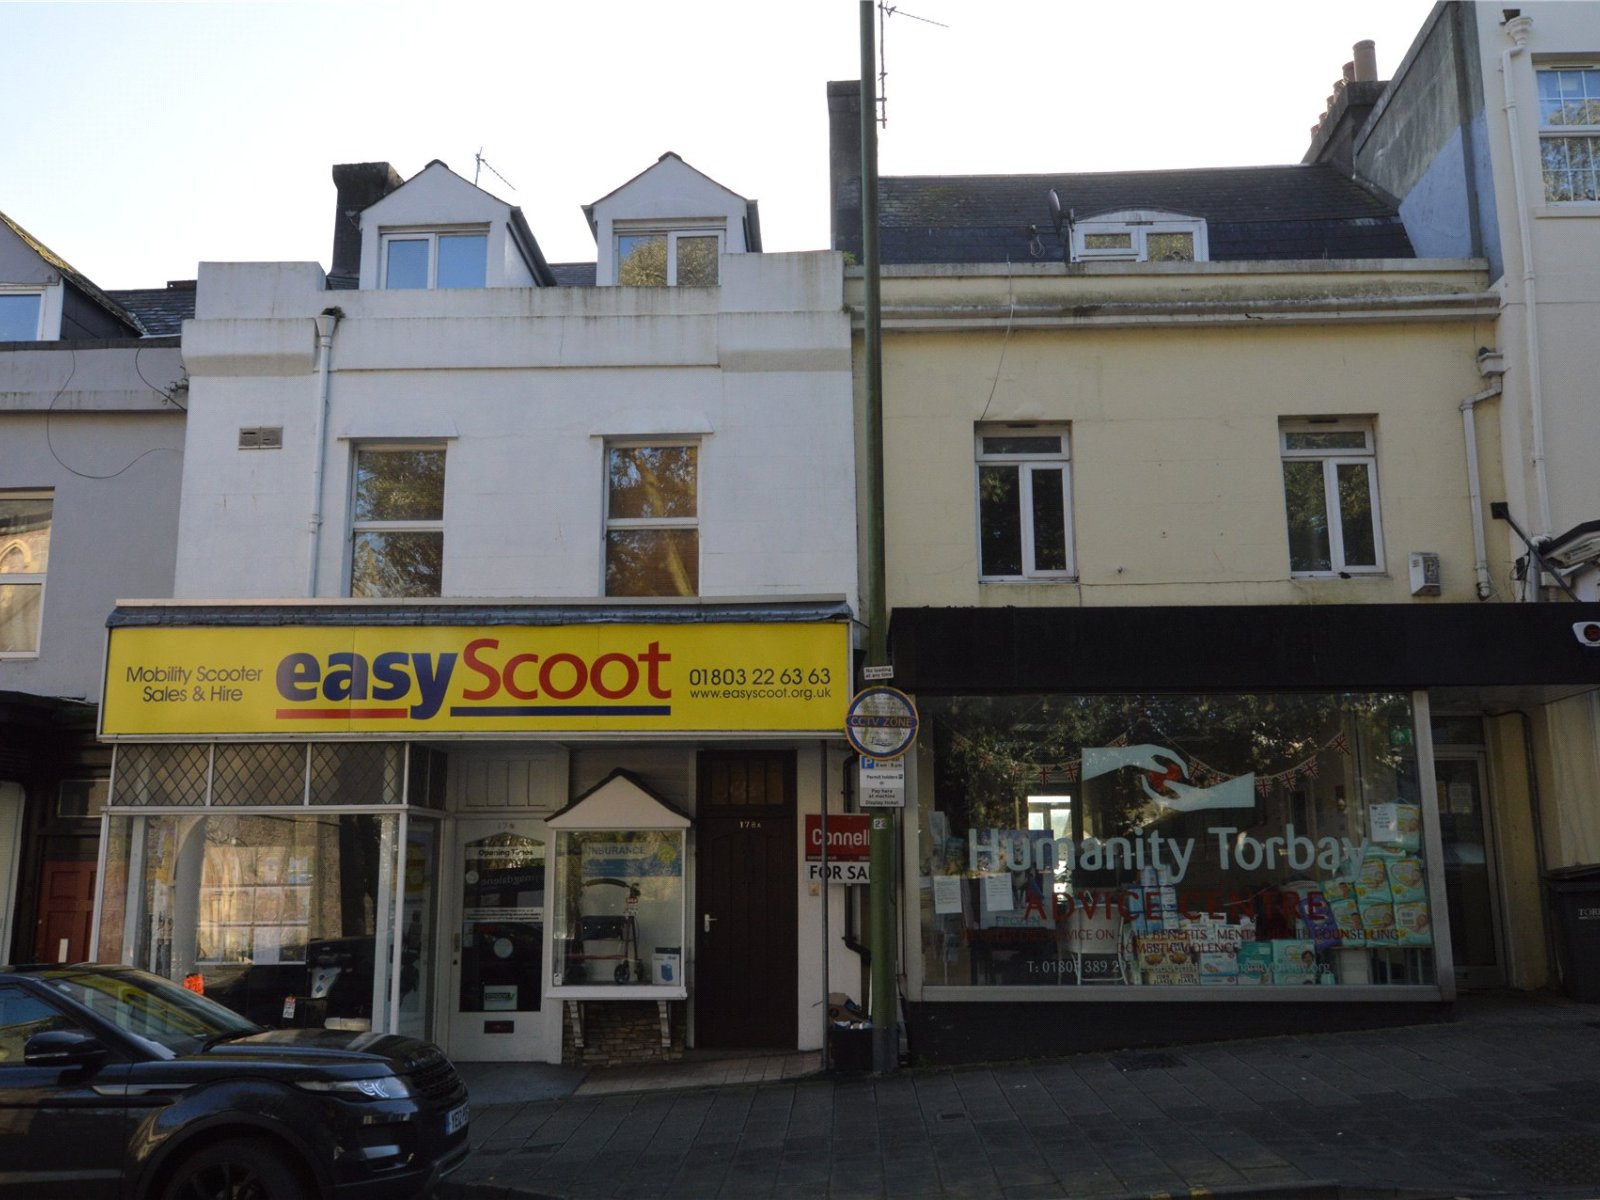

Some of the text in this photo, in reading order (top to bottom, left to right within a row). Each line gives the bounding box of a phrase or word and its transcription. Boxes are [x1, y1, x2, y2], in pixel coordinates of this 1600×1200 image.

[126, 665, 263, 685] Mobility Scooter
[689, 668, 831, 686] 01803 22 63 63
[143, 685, 243, 702] Sales & Hire
[690, 686, 832, 701] www.easyscoot.org.uk
[850, 716, 913, 727] CCTV ZONE
[478, 849, 510, 858] Opening
[968, 823, 1369, 884] Humanity Torbay
[810, 865, 871, 880] FOR SA
[1024, 891, 1161, 921] ADVICE
[1096, 929, 1115, 940] ON
[1084, 961, 1108, 973] 389
